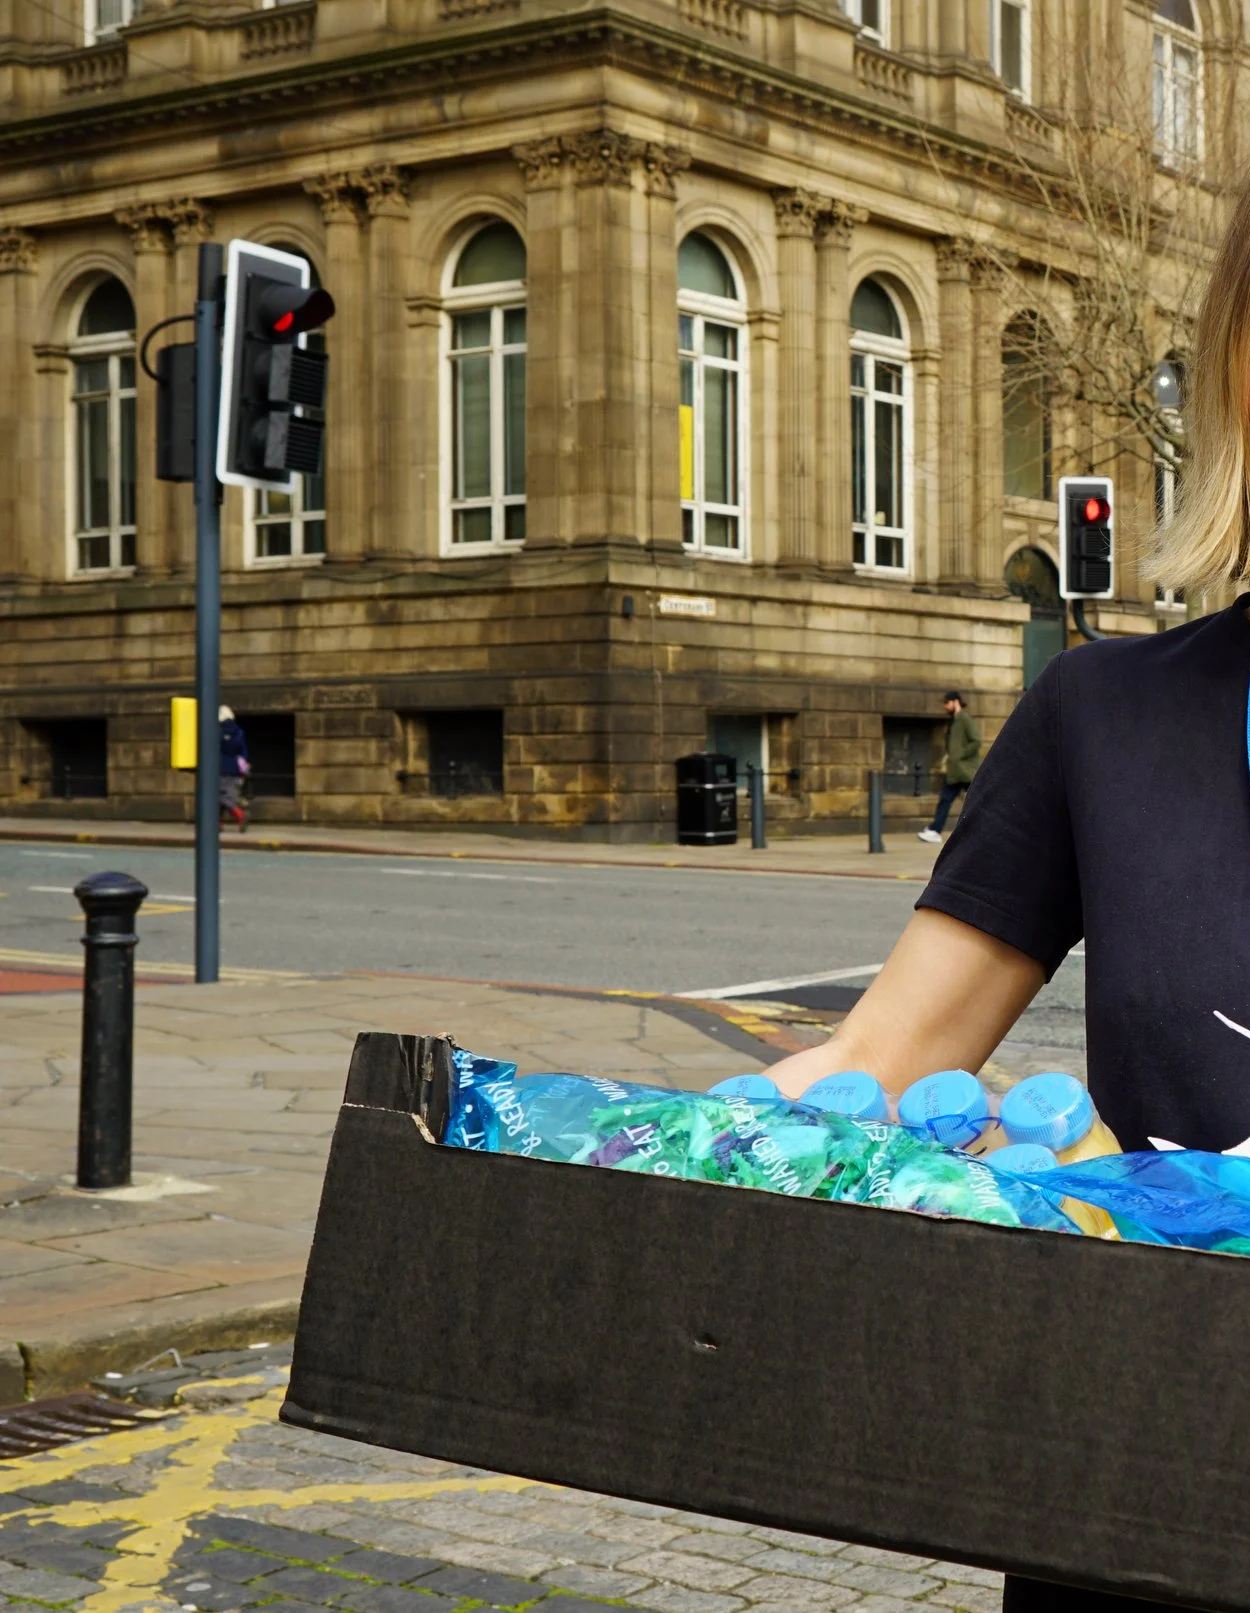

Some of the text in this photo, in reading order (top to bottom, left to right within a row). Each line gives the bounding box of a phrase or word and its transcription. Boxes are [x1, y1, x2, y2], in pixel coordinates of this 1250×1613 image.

[484, 1080, 530, 1137] READY
[520, 1130, 542, 1156] &
[622, 1123, 663, 1159] EAT
[751, 1136, 803, 1196] WASHED
